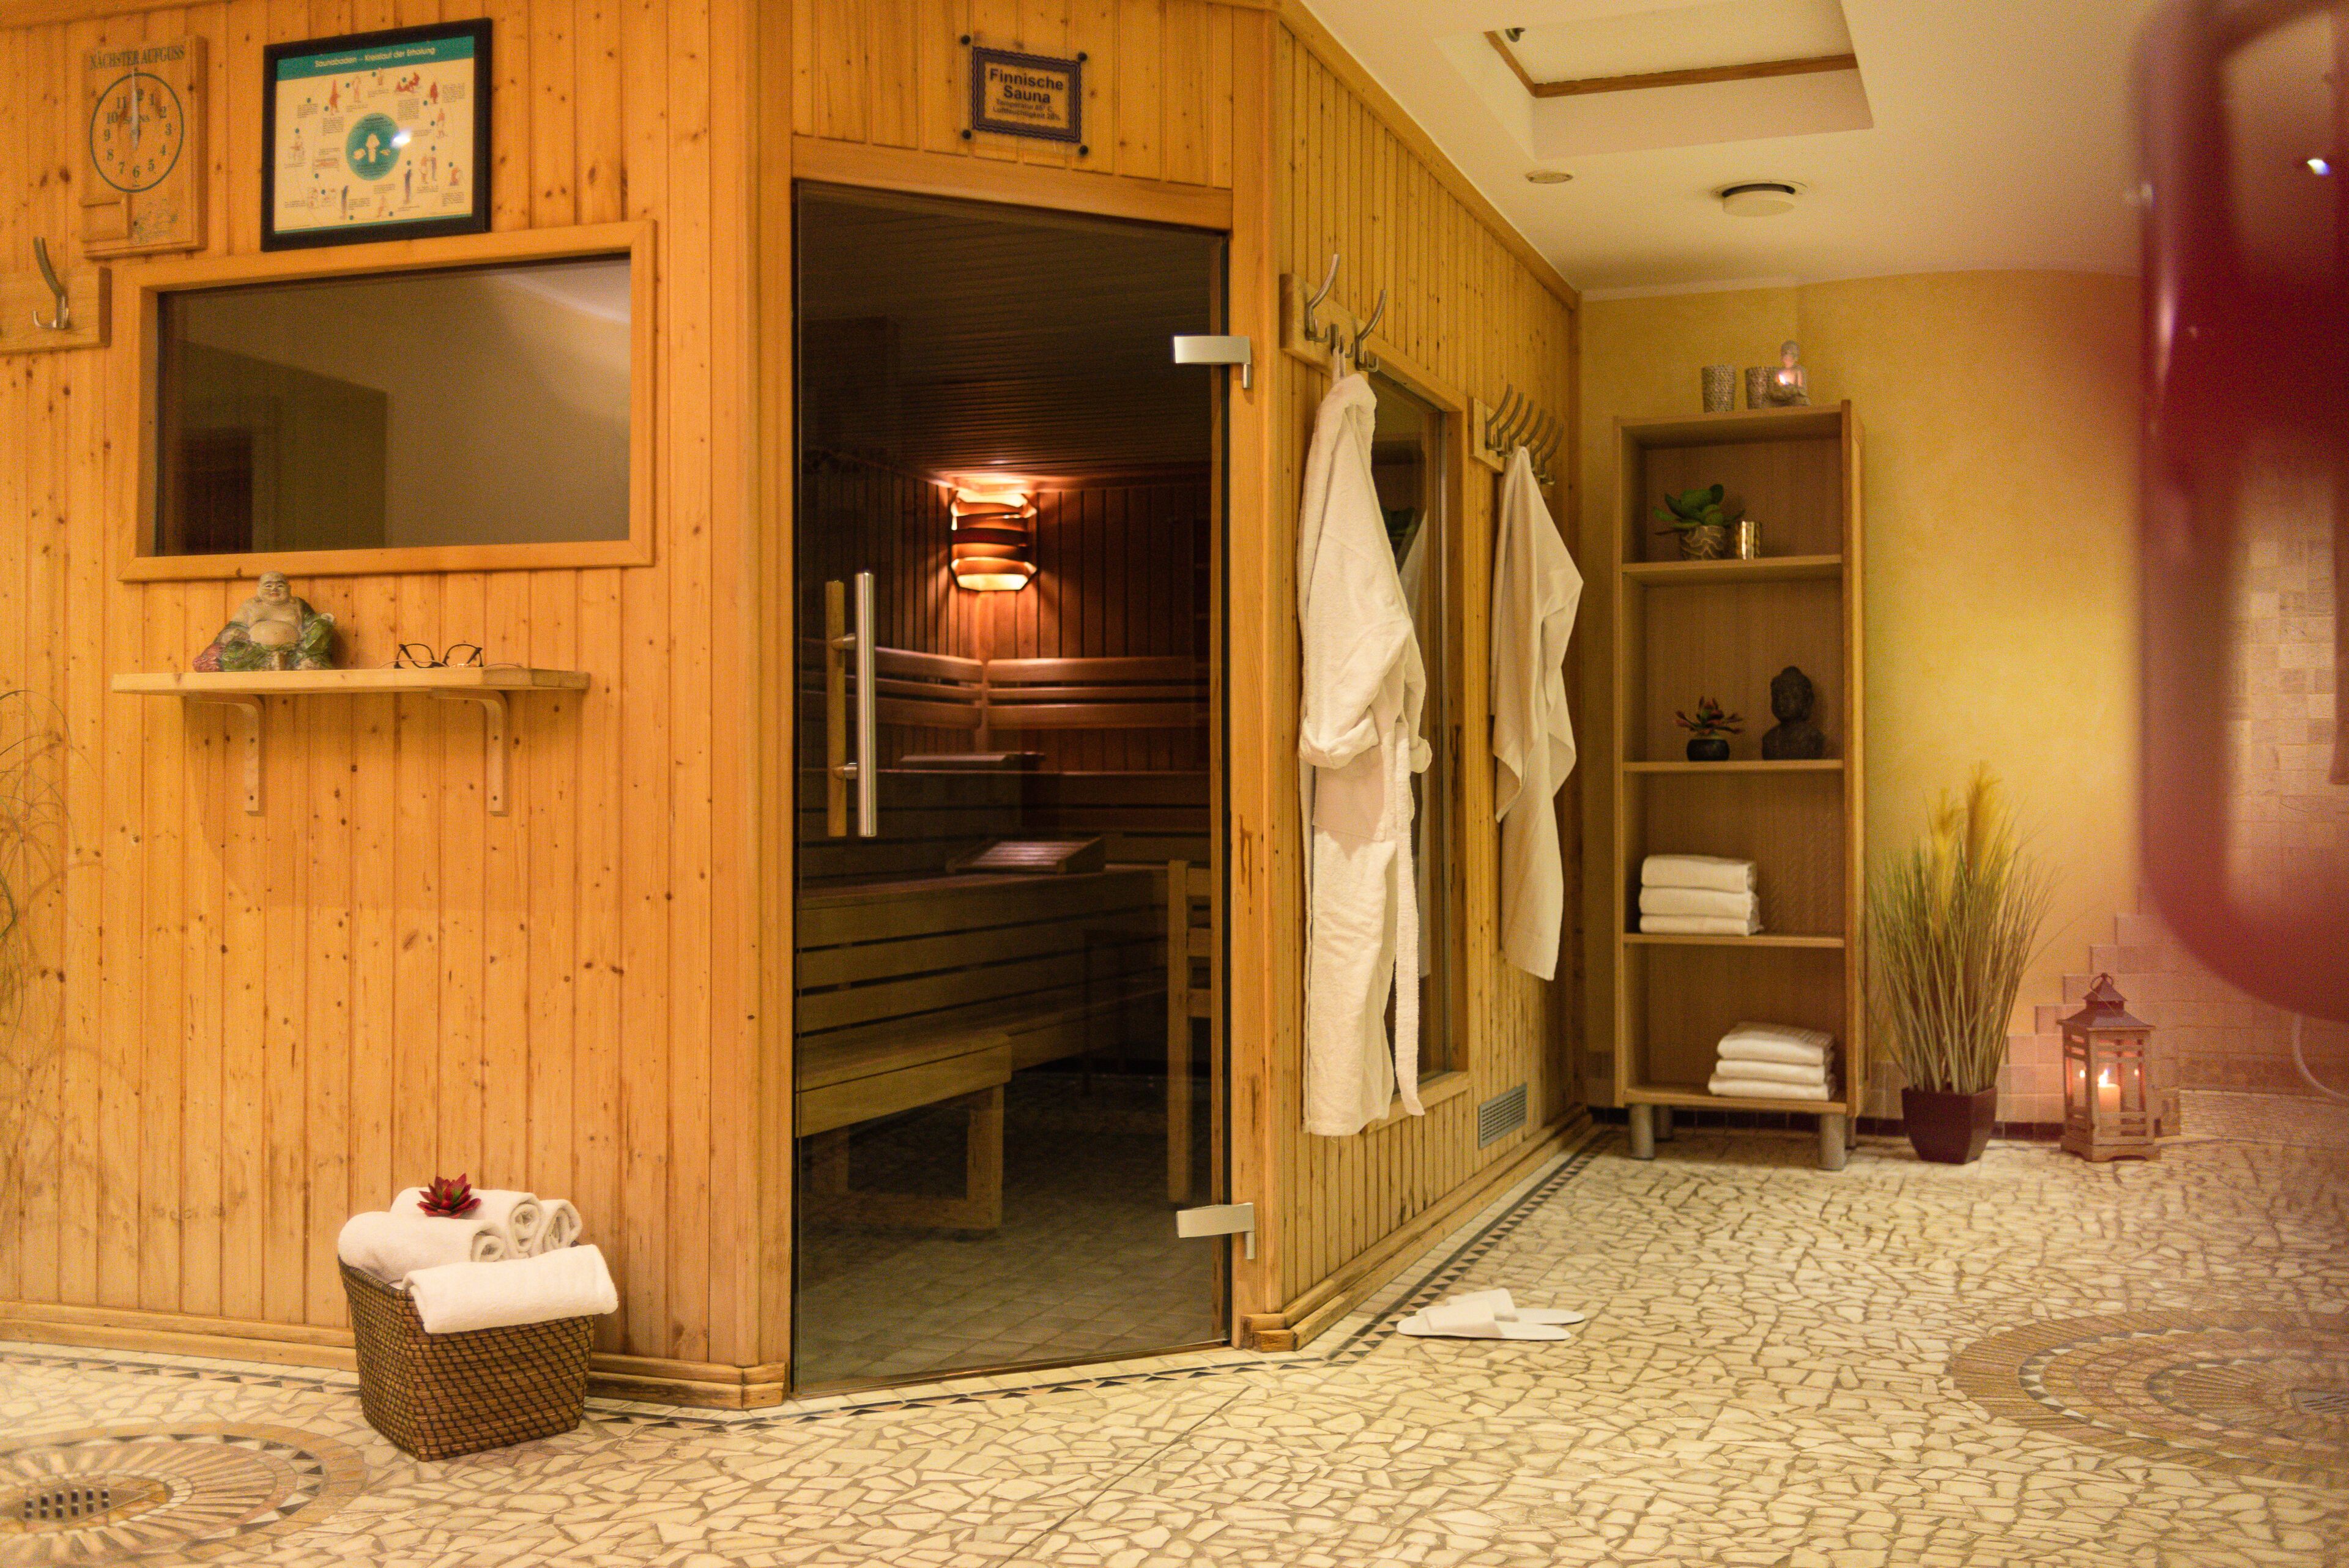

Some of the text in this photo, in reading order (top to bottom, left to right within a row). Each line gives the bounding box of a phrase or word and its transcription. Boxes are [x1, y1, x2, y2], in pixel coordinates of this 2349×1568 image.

[141, 45, 185, 64] AUFGUSS
[989, 68, 1064, 91] Finnische
[1004, 84, 1051, 103] Sauna
[116, 96, 127, 109] 11
[106, 112, 119, 124] 10
[158, 106, 166, 119] 2
[104, 128, 111, 141] 9
[165, 122, 172, 136] 3
[107, 149, 114, 161] 8
[161, 144, 167, 156] 4
[119, 161, 125, 174] 7
[132, 165, 140, 177] 6
[147, 158, 155, 172] 5
